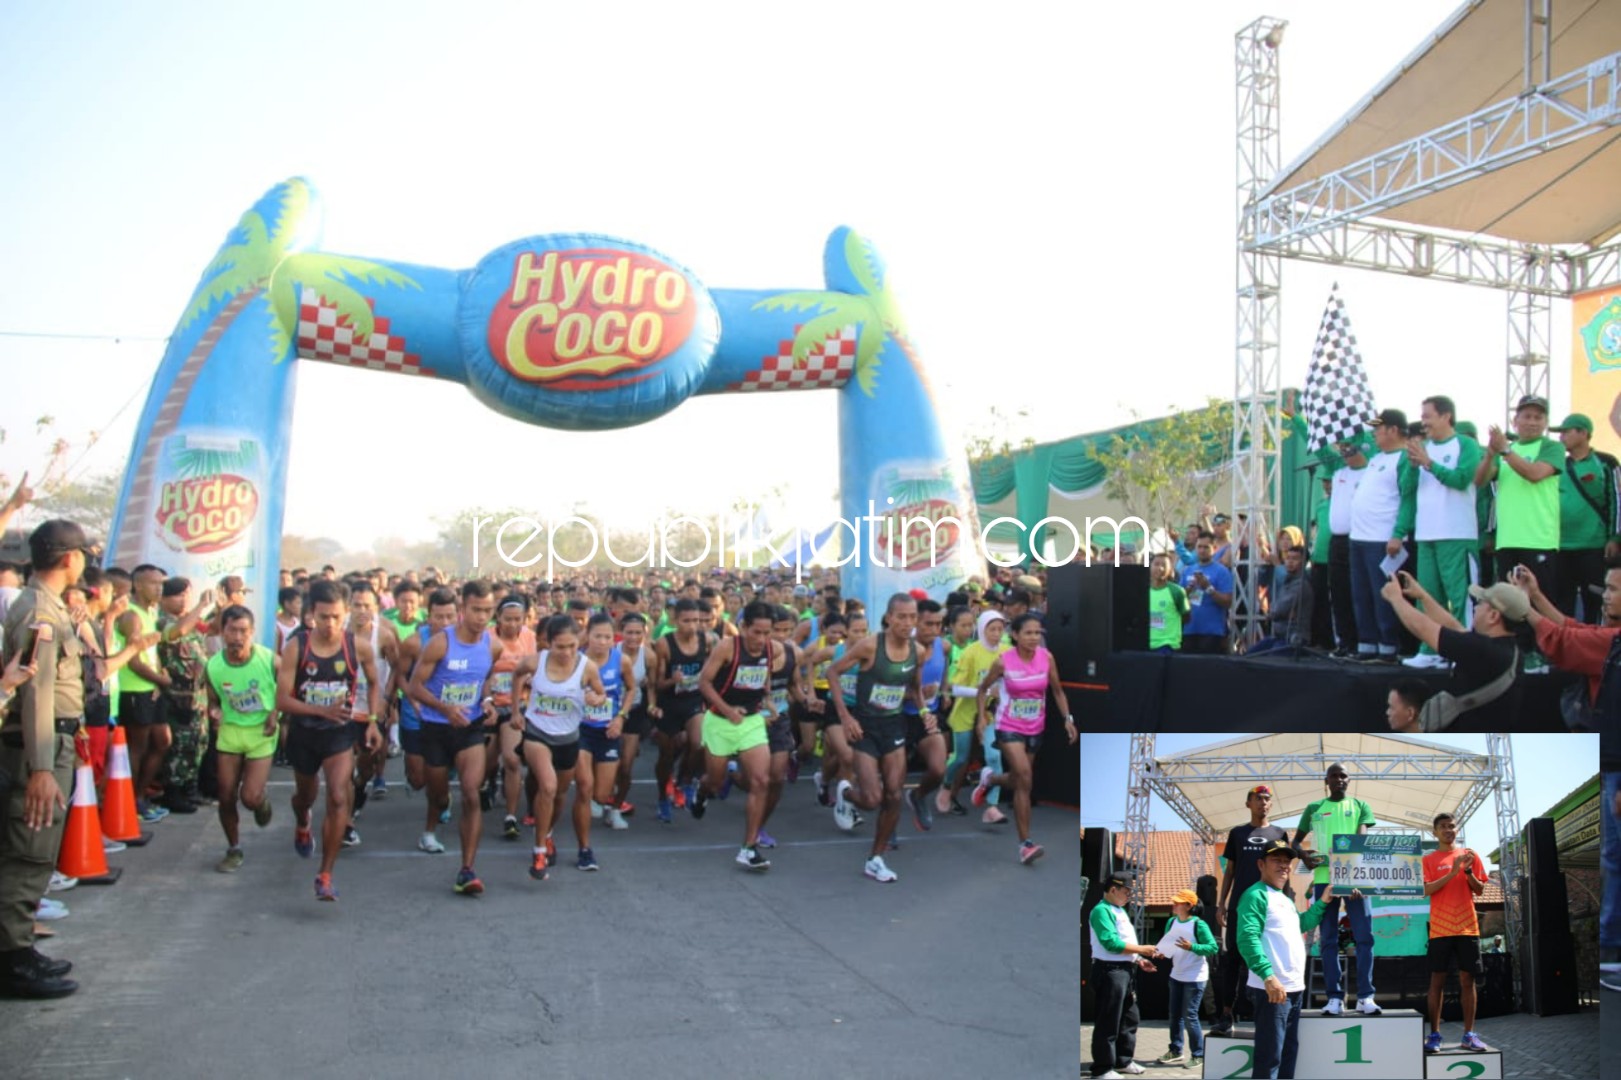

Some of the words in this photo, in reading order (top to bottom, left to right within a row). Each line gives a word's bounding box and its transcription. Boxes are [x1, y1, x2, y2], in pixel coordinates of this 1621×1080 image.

[512, 252, 686, 310] Hydro
[506, 302, 663, 378] Coco
[161, 479, 252, 513] Hydro
[164, 506, 242, 548] Coco
[1362, 851, 1386, 861] JUARA
[1221, 1044, 1255, 1079] 2
[1332, 1024, 1373, 1064] 1
